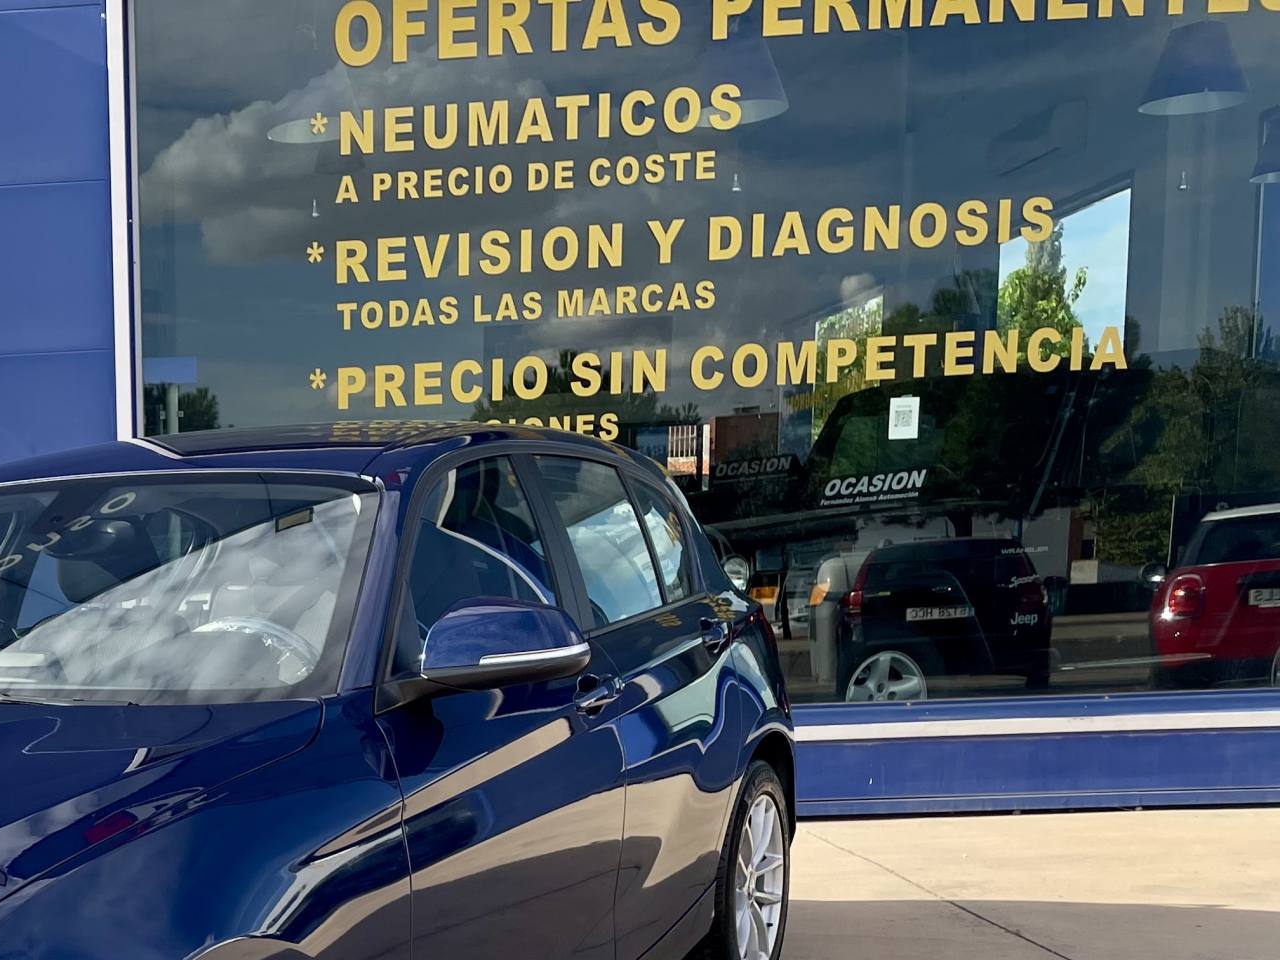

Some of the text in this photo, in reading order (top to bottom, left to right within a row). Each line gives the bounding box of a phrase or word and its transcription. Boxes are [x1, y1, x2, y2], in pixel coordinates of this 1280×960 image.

[334, 0, 682, 66] OFERTAS
[335, 151, 717, 204] A PRECIO DE COSTE
[647, 218, 685, 264] Y
[708, 196, 1055, 261] DIAGNOSIS
[336, 280, 717, 331] TODAS LAS MARCAS
[570, 349, 667, 397] SIN
[690, 326, 1128, 391] COMPETENCIA
[715, 456, 793, 477] OCASION
[824, 469, 927, 497] OCASION
[1010, 612, 1038, 626] Jeep
